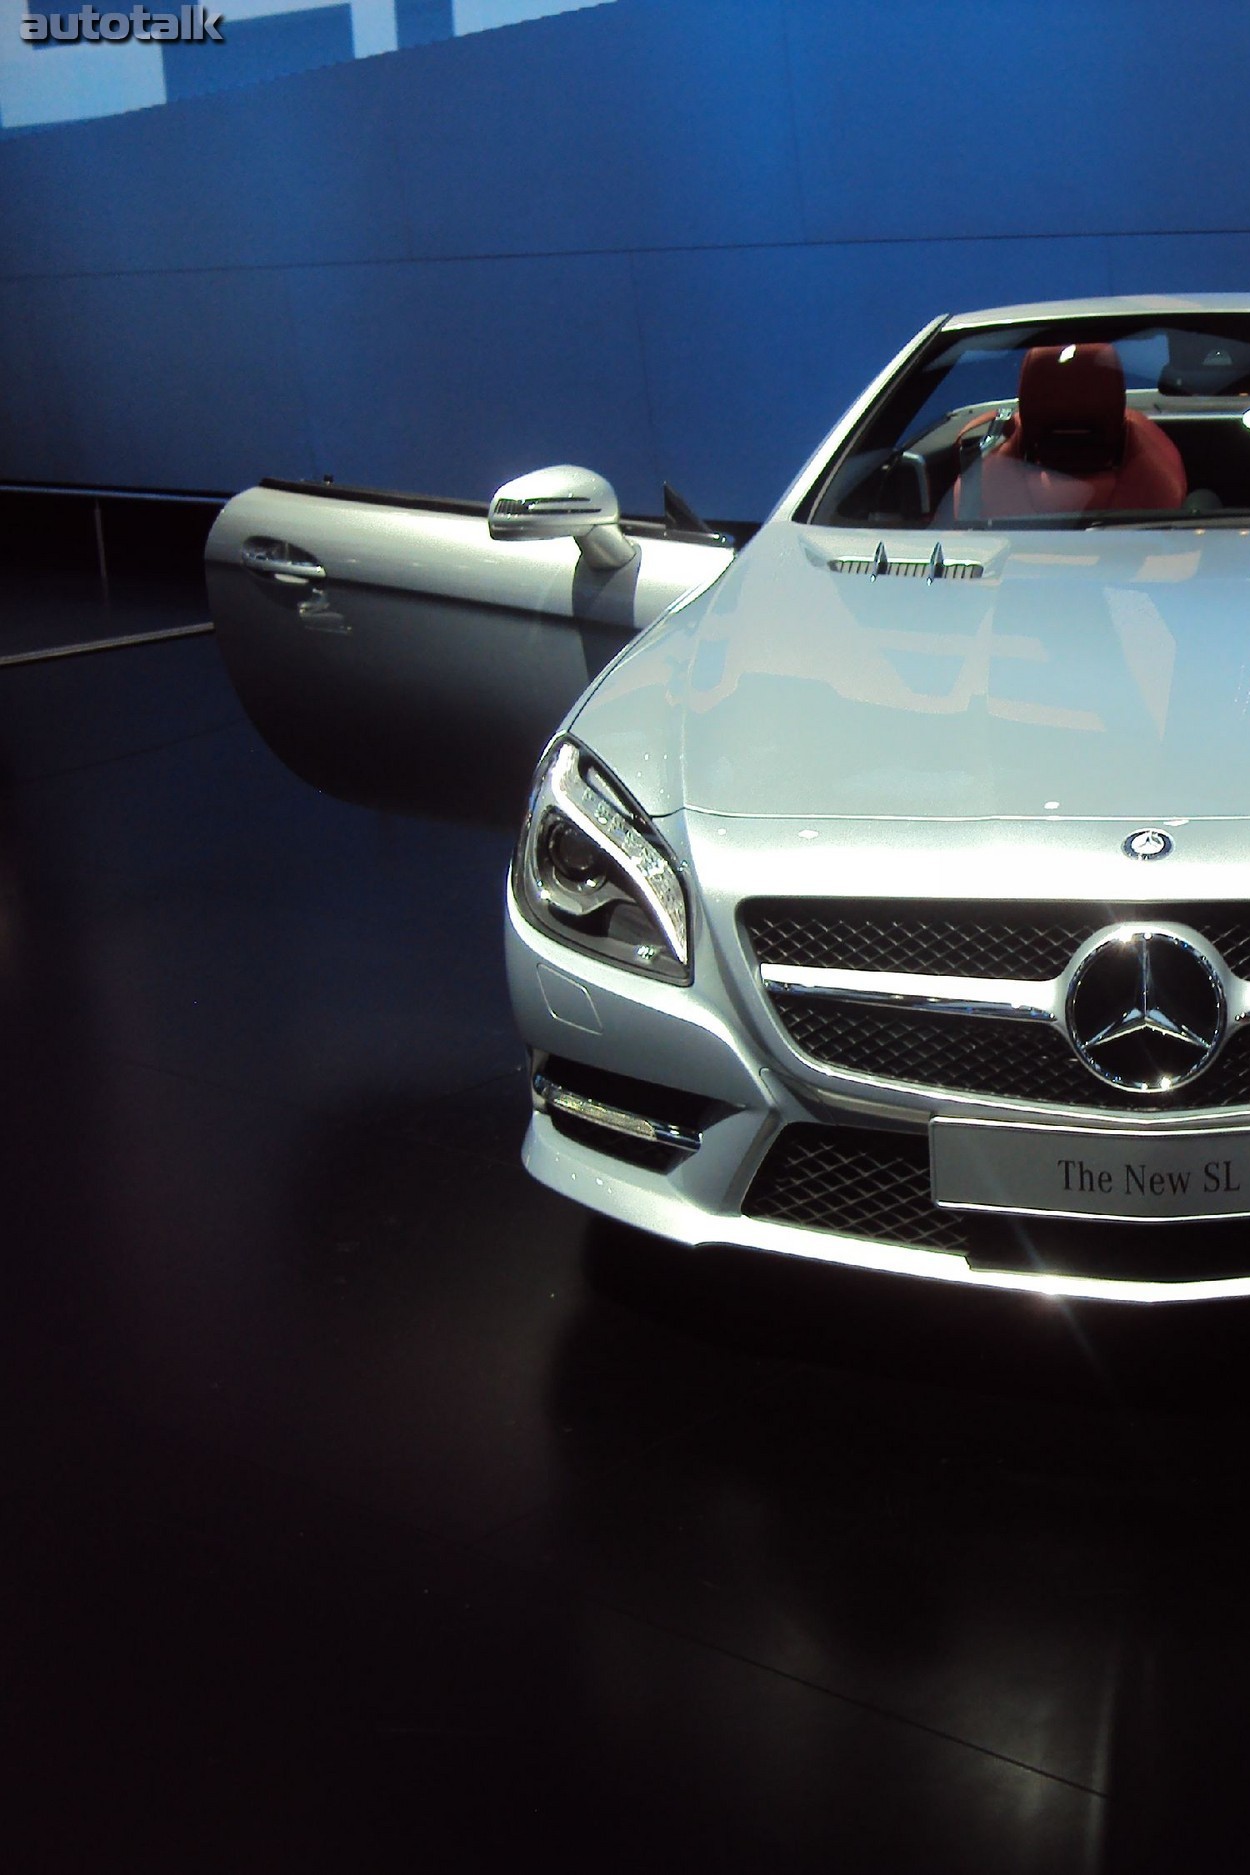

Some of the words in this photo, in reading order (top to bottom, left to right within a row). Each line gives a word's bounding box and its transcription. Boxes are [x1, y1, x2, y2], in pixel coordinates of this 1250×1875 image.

[1058, 1160, 1113, 1194] The
[1125, 1165, 1191, 1196] New
[1203, 1161, 1241, 1193] SL
